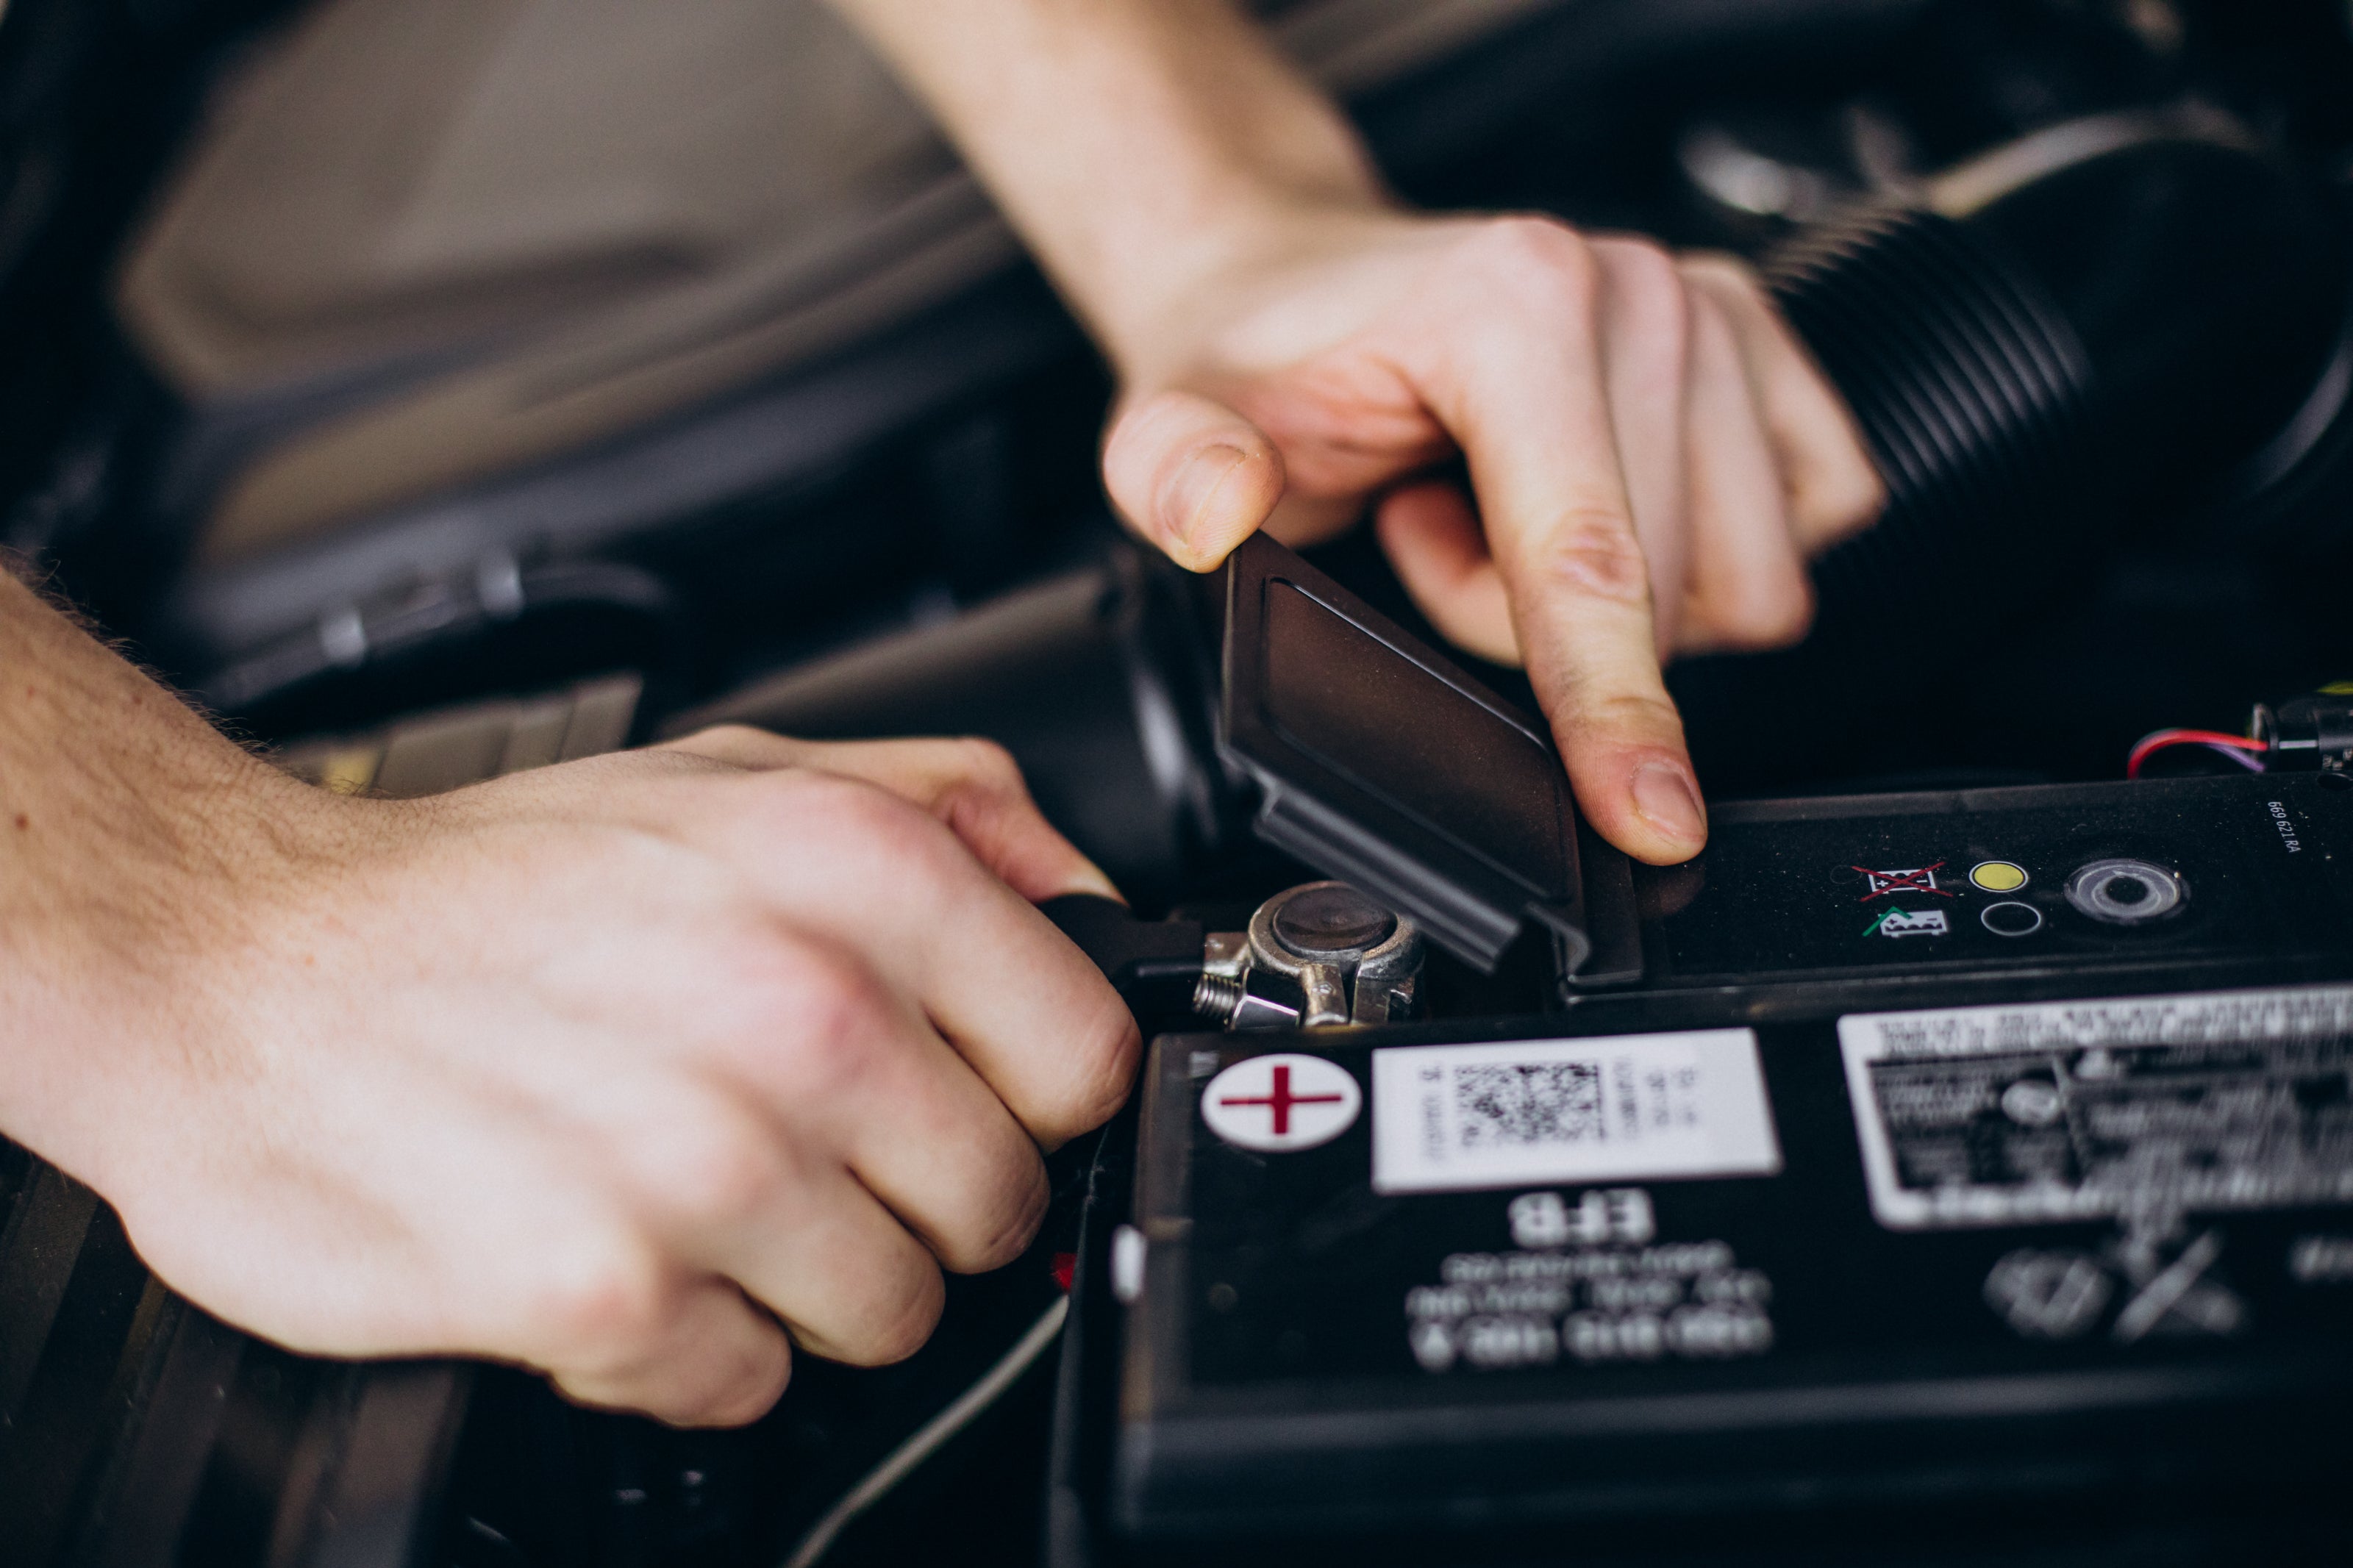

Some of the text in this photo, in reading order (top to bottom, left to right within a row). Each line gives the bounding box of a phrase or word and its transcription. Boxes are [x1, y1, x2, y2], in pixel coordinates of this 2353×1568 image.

[2268, 801, 2302, 853] 669 621 RA
[1508, 1188, 1654, 1247] EFB
